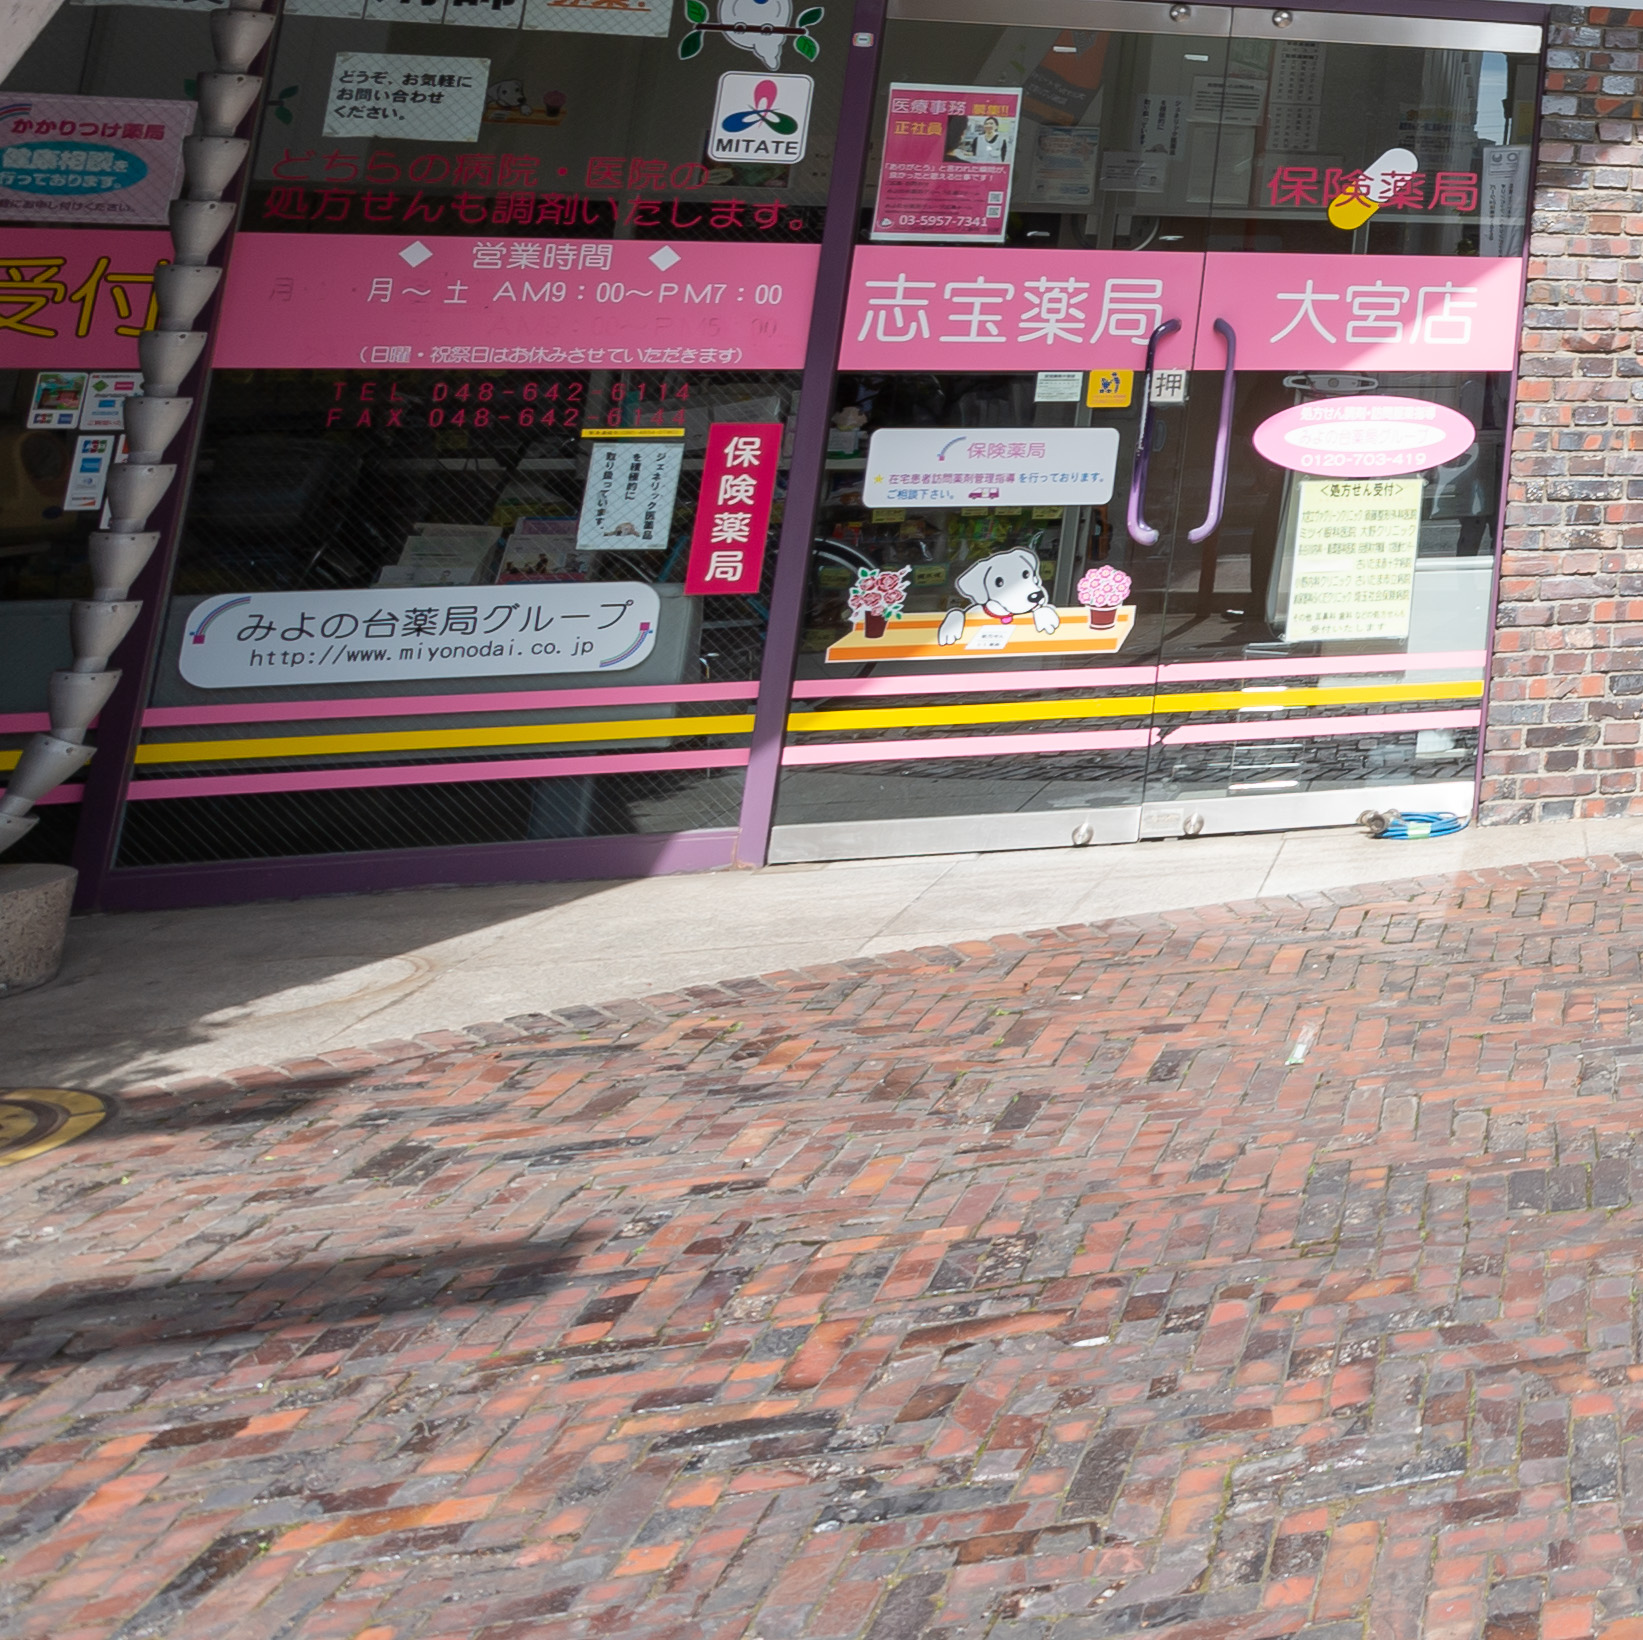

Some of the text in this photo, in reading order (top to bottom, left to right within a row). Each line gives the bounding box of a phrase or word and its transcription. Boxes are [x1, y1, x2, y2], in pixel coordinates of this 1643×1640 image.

[335, 86, 445, 104] お問い合わせ
[333, 105, 407, 121] ください。
[11, 119, 166, 141] かかりつけ薬局
[894, 121, 943, 136] 正社員
[716, 138, 799, 156] MITATE
[271, 148, 710, 191] どちらの病院・医院の
[1266, 165, 1478, 212] 保険薬局
[262, 187, 804, 231] 処方せんも調剤いたします。
[899, 214, 988, 227] 03-5957-7341
[472, 241, 613, 271] 営業時間
[857, 272, 1479, 346] 志宝薬局 大宮店
[333, 381, 691, 403] TEL 048-642-6114
[1154, 371, 1183, 397] 押
[326, 407, 687, 428] FAX 048-642-6144
[966, 441, 1046, 460] 保険薬局
[1301, 452, 1427, 467] 0120-703-419
[886, 488, 955, 501] ご相談下さい。
[704, 435, 762, 582] 保険薬局
[236, 599, 635, 643] みよの台薬局グループ
[250, 636, 595, 669] http://www.miyonodai.co.jp
